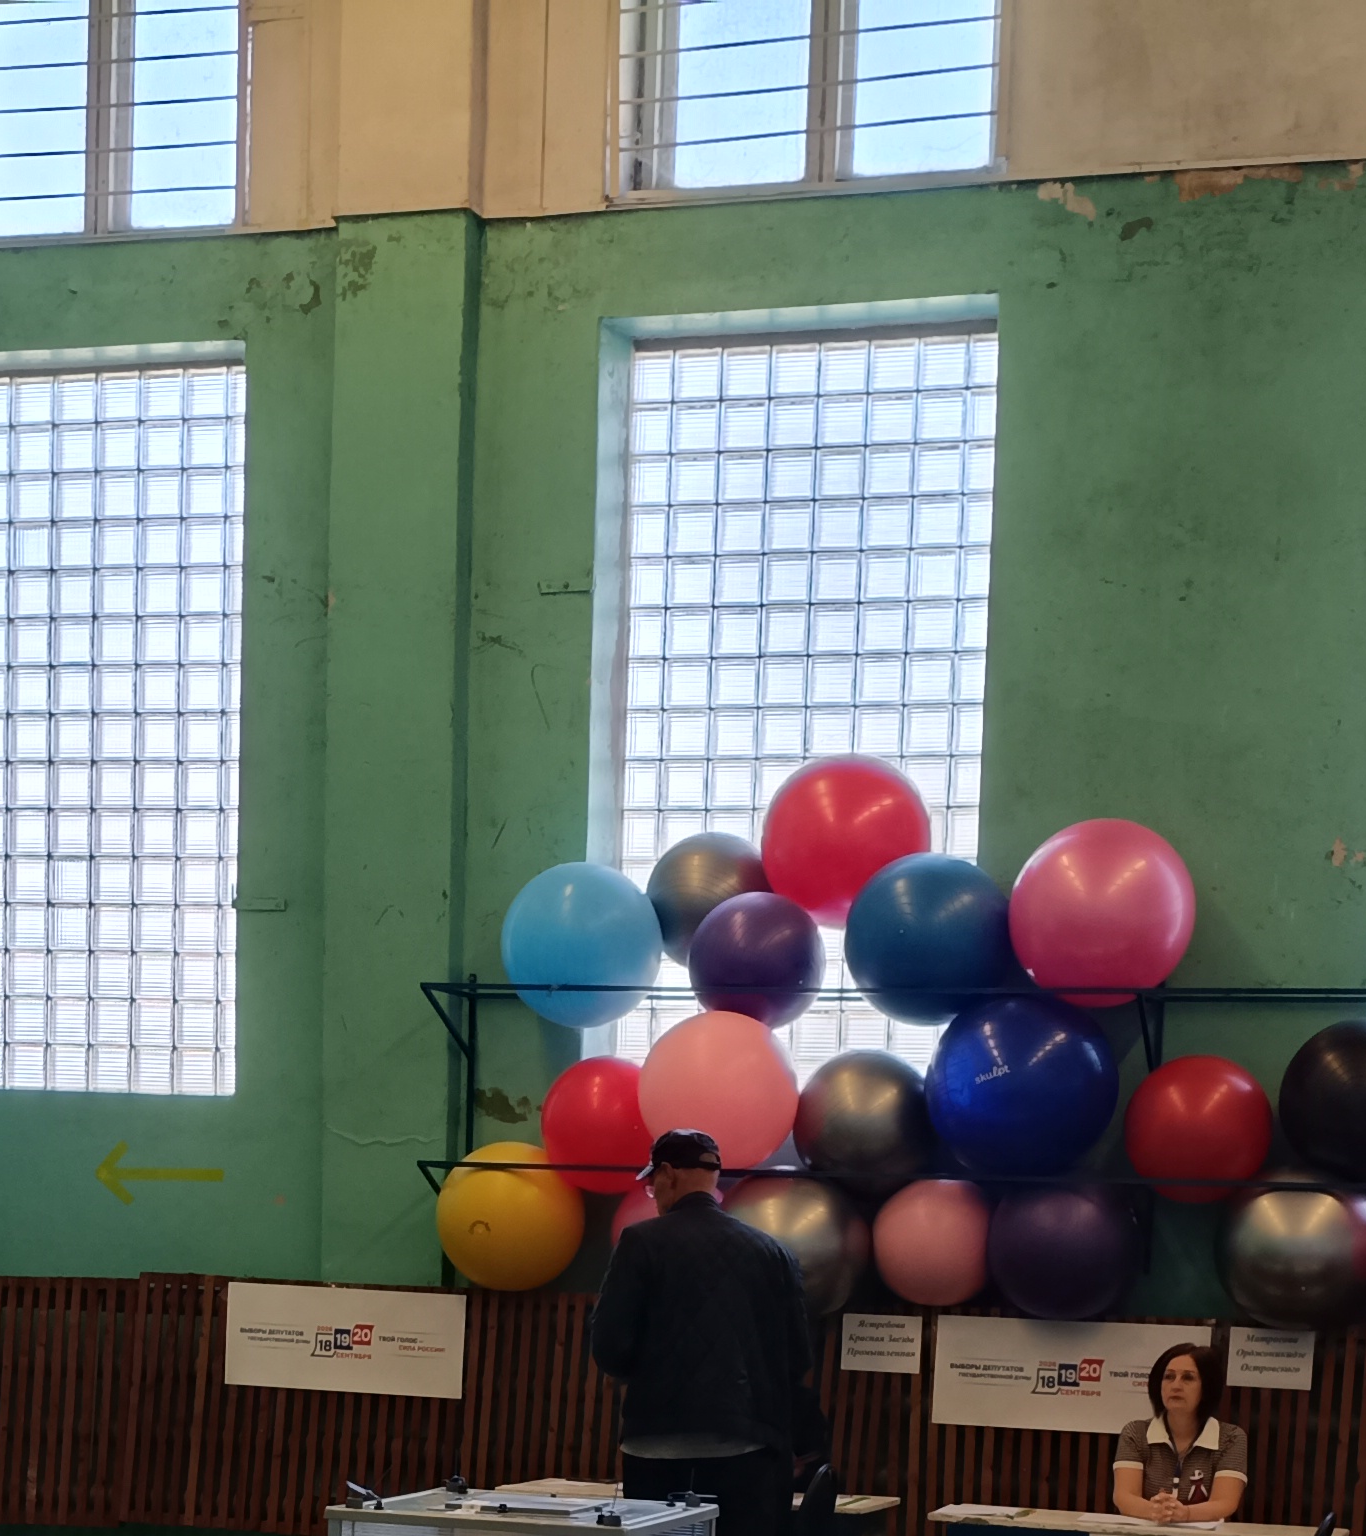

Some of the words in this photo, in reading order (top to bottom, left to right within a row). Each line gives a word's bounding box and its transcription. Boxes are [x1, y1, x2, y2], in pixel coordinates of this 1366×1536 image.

[974, 1064, 1011, 1085] skulpt
[239, 1327, 267, 1335] ВЫБОРЫ
[268, 1329, 304, 1337] ДЕПУТАТОВ
[353, 1328, 371, 1342] 20
[335, 1333, 350, 1347] 19
[396, 1336, 418, 1344] ГОЛОС
[848, 1333, 885, 1344] Красная
[318, 1339, 333, 1352] 18
[335, 1352, 372, 1360] СЕНТЯБРЯ
[949, 1362, 981, 1370] ВЫБОРЫ
[982, 1364, 1024, 1373] ДЕПУТАТОВ
[1080, 1363, 1100, 1378] 20
[1060, 1369, 1076, 1383] 19
[1130, 1371, 1150, 1379] ГОЛО
[1040, 1375, 1056, 1389] 18
[1060, 1389, 1101, 1397] СЕНТЯБРЯ
